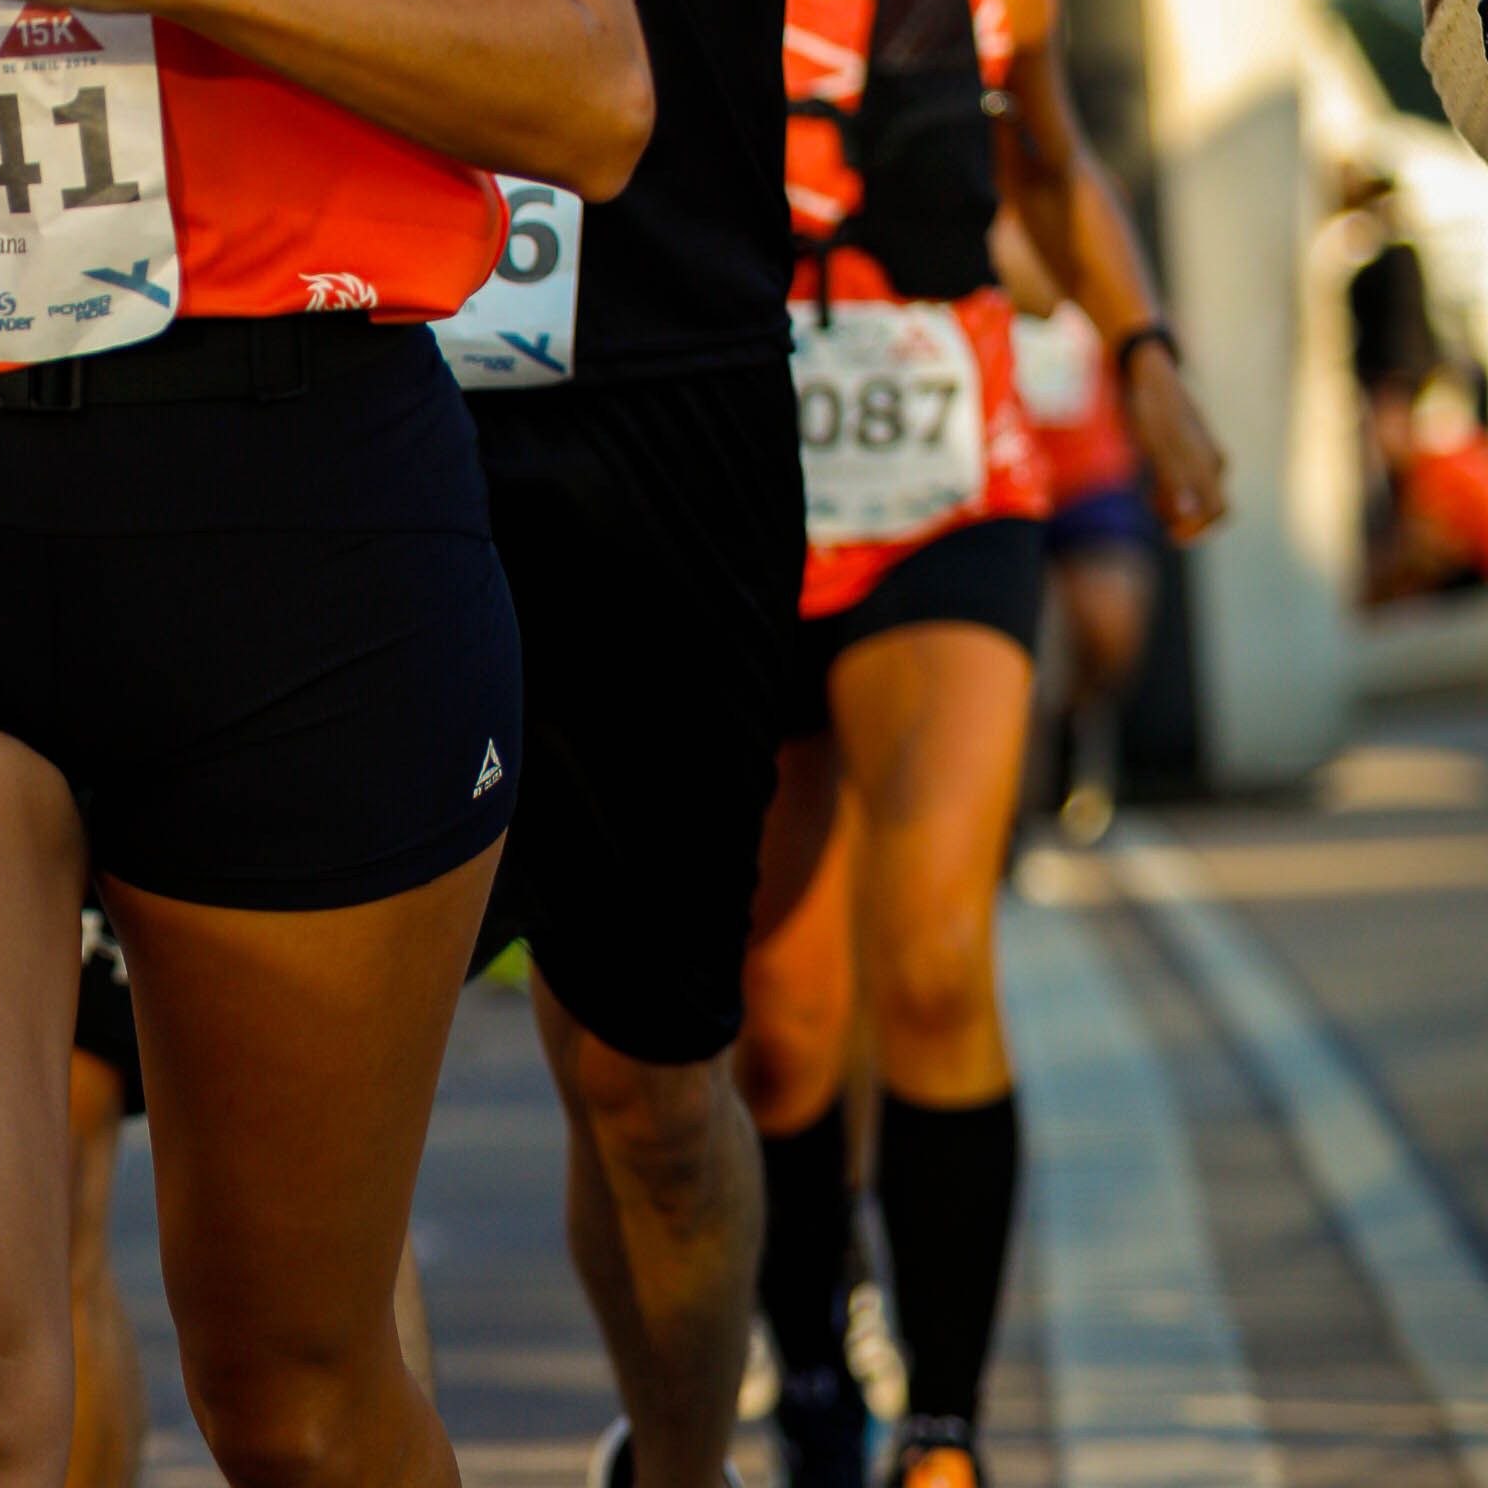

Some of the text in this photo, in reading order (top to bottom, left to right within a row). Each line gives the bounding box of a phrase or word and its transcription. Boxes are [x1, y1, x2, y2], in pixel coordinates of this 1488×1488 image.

[16, 15, 75, 48] 15K
[495, 185, 560, 284] 6
[799, 379, 957, 454] 087
